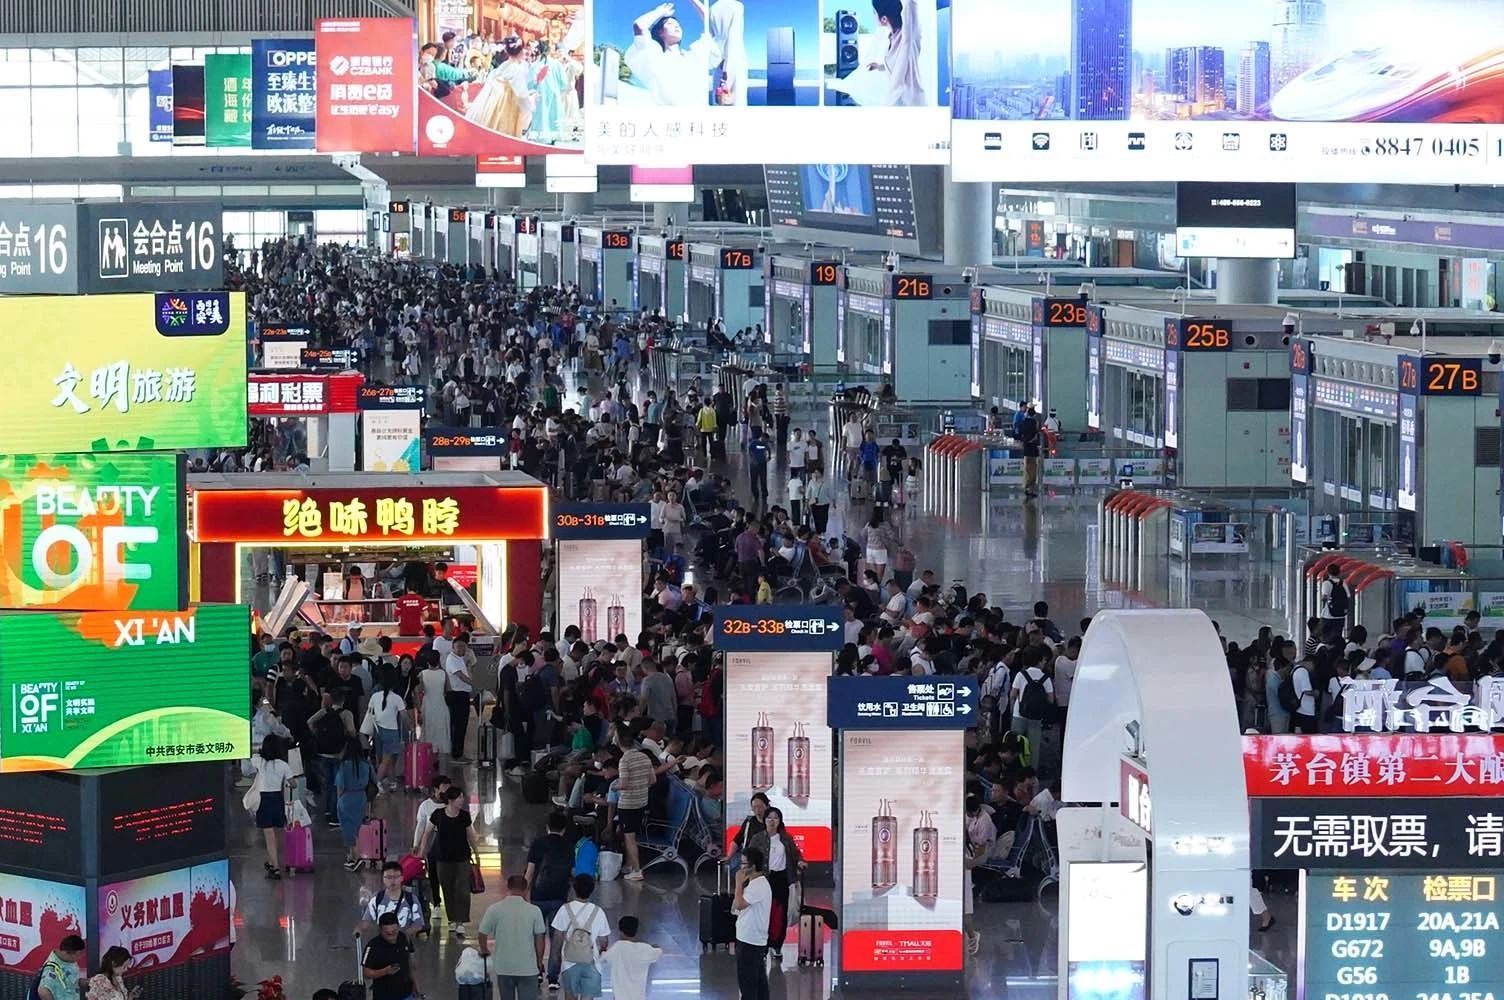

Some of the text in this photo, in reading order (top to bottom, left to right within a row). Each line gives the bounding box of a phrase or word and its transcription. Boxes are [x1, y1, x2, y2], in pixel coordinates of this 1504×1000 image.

[1375, 137, 1424, 156] 8847
[1432, 138, 1480, 157] 0405
[35, 223, 68, 275] 16
[132, 219, 215, 271] 会合点 16
[605, 234, 628, 247] 13B
[10, 259, 31, 276] Point
[132, 259, 184, 278] Meeting Point
[725, 252, 751, 267] 17B
[898, 278, 929, 296] 21B
[1051, 303, 1088, 323] 23B
[1187, 324, 1229, 347] 25B
[52, 361, 195, 413] 文明旅游
[1428, 363, 1479, 391] 27B
[36, 485, 160, 517] BEAUTY
[283, 497, 460, 536] 绝味鸭脖
[557, 513, 605, 527] 30B-31B
[32, 524, 158, 590] OF
[723, 619, 785, 634] 32B-33B
[20, 693, 58, 723] OF
[146, 742, 235, 758] 中共西安市委文明办
[1333, 876, 1495, 902] 车次 检票口
[1326, 911, 1500, 933] D1917 20A,21A
[1331, 938, 1486, 960] G672 9A,9B
[1336, 966, 1470, 985] G56 1B
